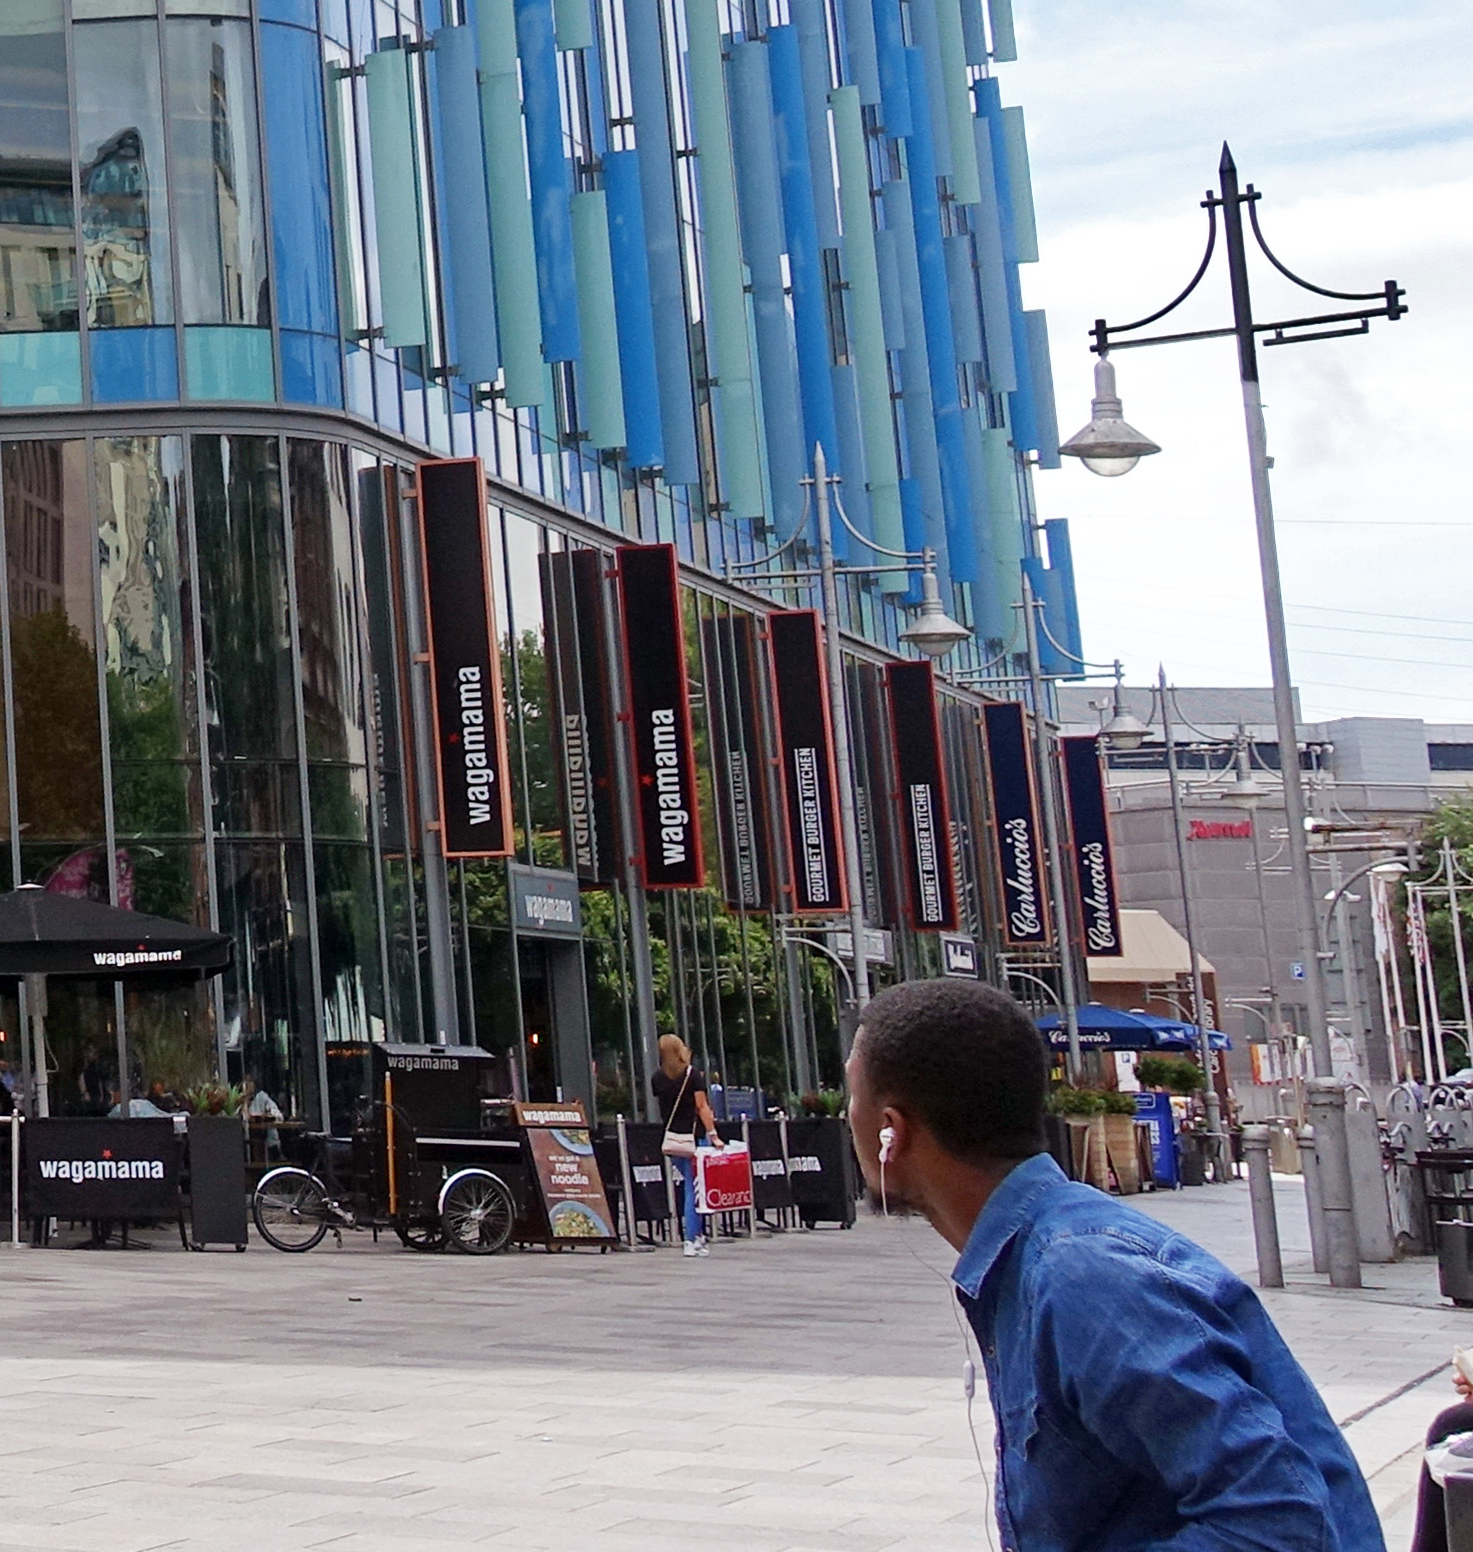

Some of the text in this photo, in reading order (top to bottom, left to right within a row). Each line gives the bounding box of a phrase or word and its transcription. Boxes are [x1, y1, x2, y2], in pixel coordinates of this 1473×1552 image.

[459, 666, 494, 825] wagamama
[652, 709, 689, 865] wagamama
[799, 748, 824, 902] GOURMET BURGER KITCHEN
[915, 784, 939, 921] GOURMET BURGER KITCHEN
[1005, 818, 1040, 937] Carluccio's
[1082, 842, 1115, 950] Carluccio's
[94, 950, 181, 966] wagamama
[387, 1056, 459, 1071] wagamama
[523, 1111, 581, 1124] wagamama
[40, 1159, 164, 1183] wagamama
[555, 1163, 578, 1172] new
